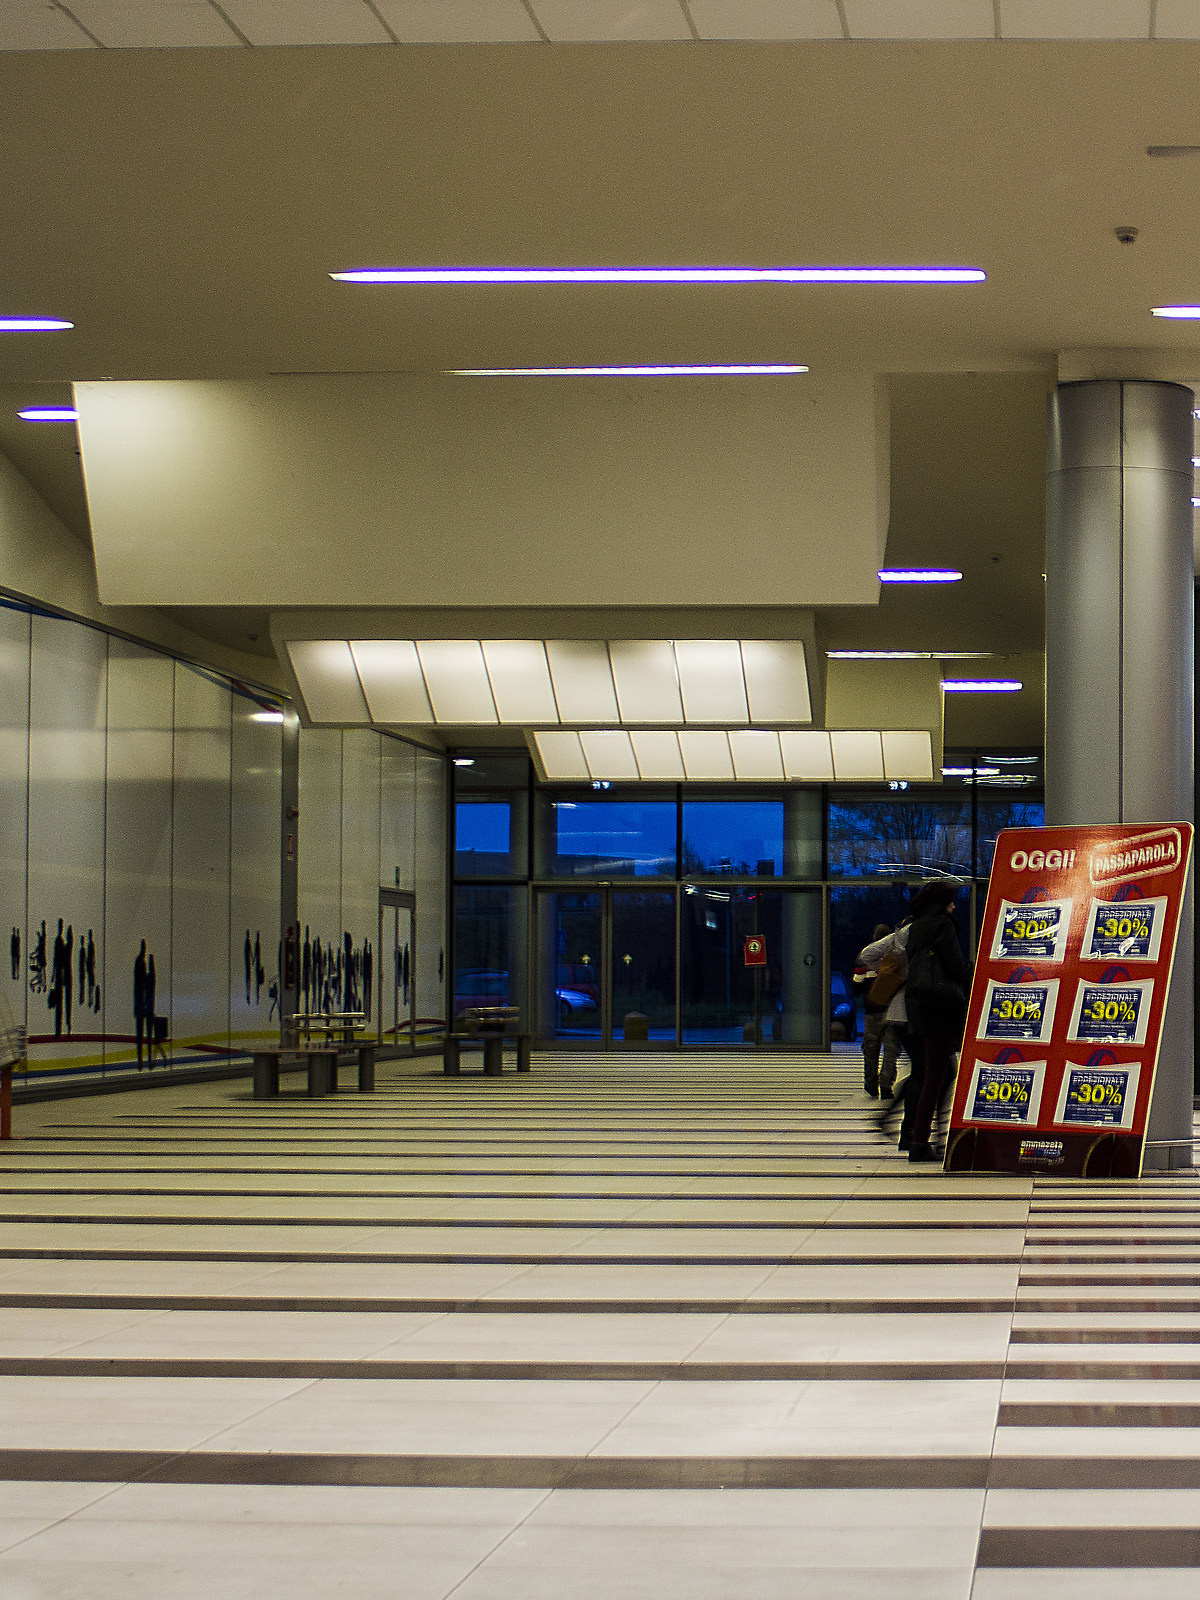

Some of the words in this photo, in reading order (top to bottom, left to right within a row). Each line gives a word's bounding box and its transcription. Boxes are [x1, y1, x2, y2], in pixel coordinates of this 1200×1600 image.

[1010, 849, 1076, 872] OGGI!
[1096, 841, 1176, 875] PASSAPAROLA
[1097, 918, 1149, 939] -30%
[993, 1001, 1041, 1021] -30%
[1084, 1001, 1136, 1022] -30%
[979, 1083, 1028, 1103] -30%
[1071, 1083, 1122, 1105] -30%
